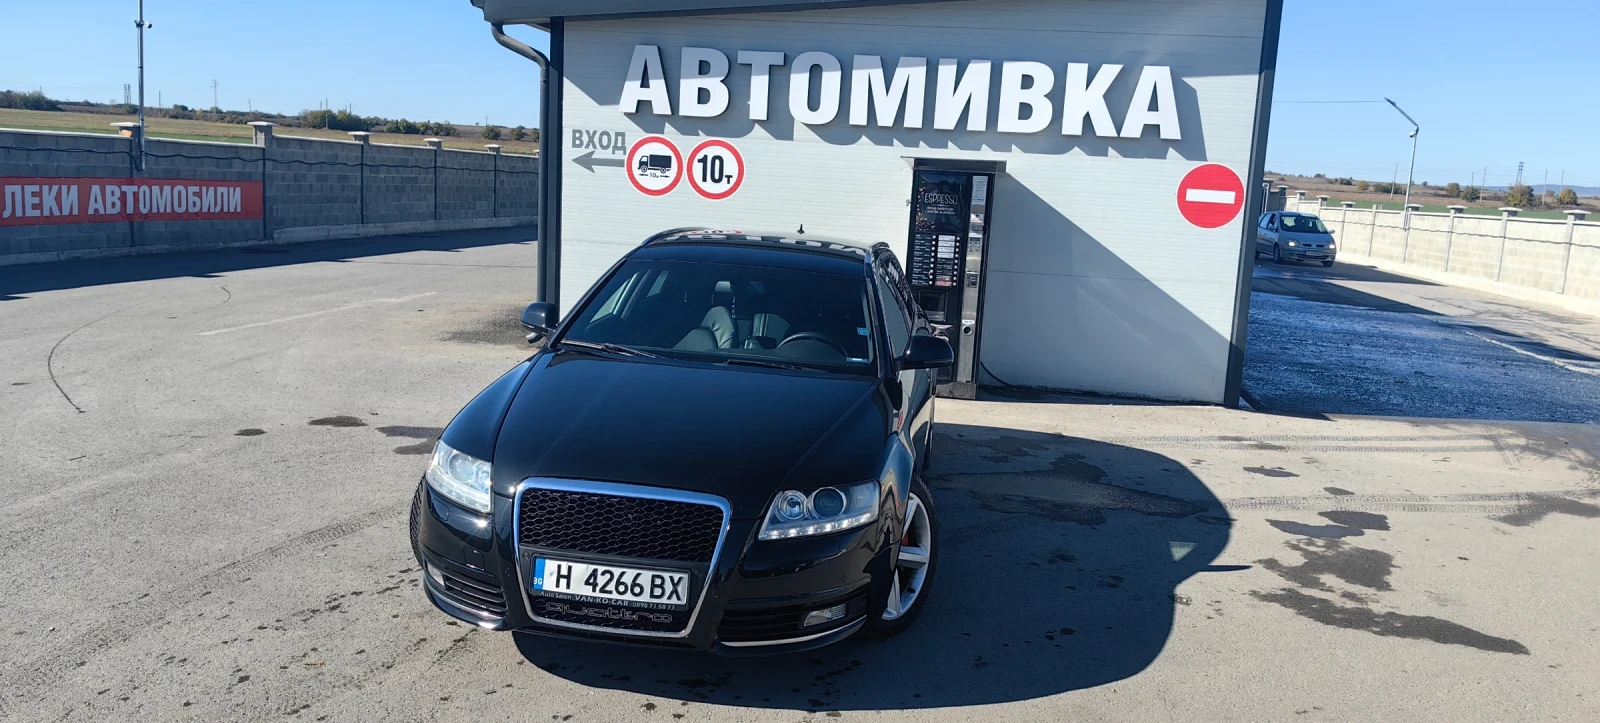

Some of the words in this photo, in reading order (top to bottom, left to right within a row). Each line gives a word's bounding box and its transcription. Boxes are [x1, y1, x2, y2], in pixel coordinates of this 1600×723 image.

[618, 44, 1182, 140] АВТОМИВКА
[571, 129, 627, 155] ВХОД
[2, 184, 79, 218] ЛЕКИ
[87, 184, 242, 214] АВТОМОБИЛИ
[924, 192, 958, 204] ESPRESSO
[540, 590, 554, 598] Auto
[555, 592, 571, 600] Salon
[555, 564, 572, 590] H
[584, 568, 645, 598] 4266
[649, 574, 684, 602] BX
[545, 602, 673, 622] quattro
